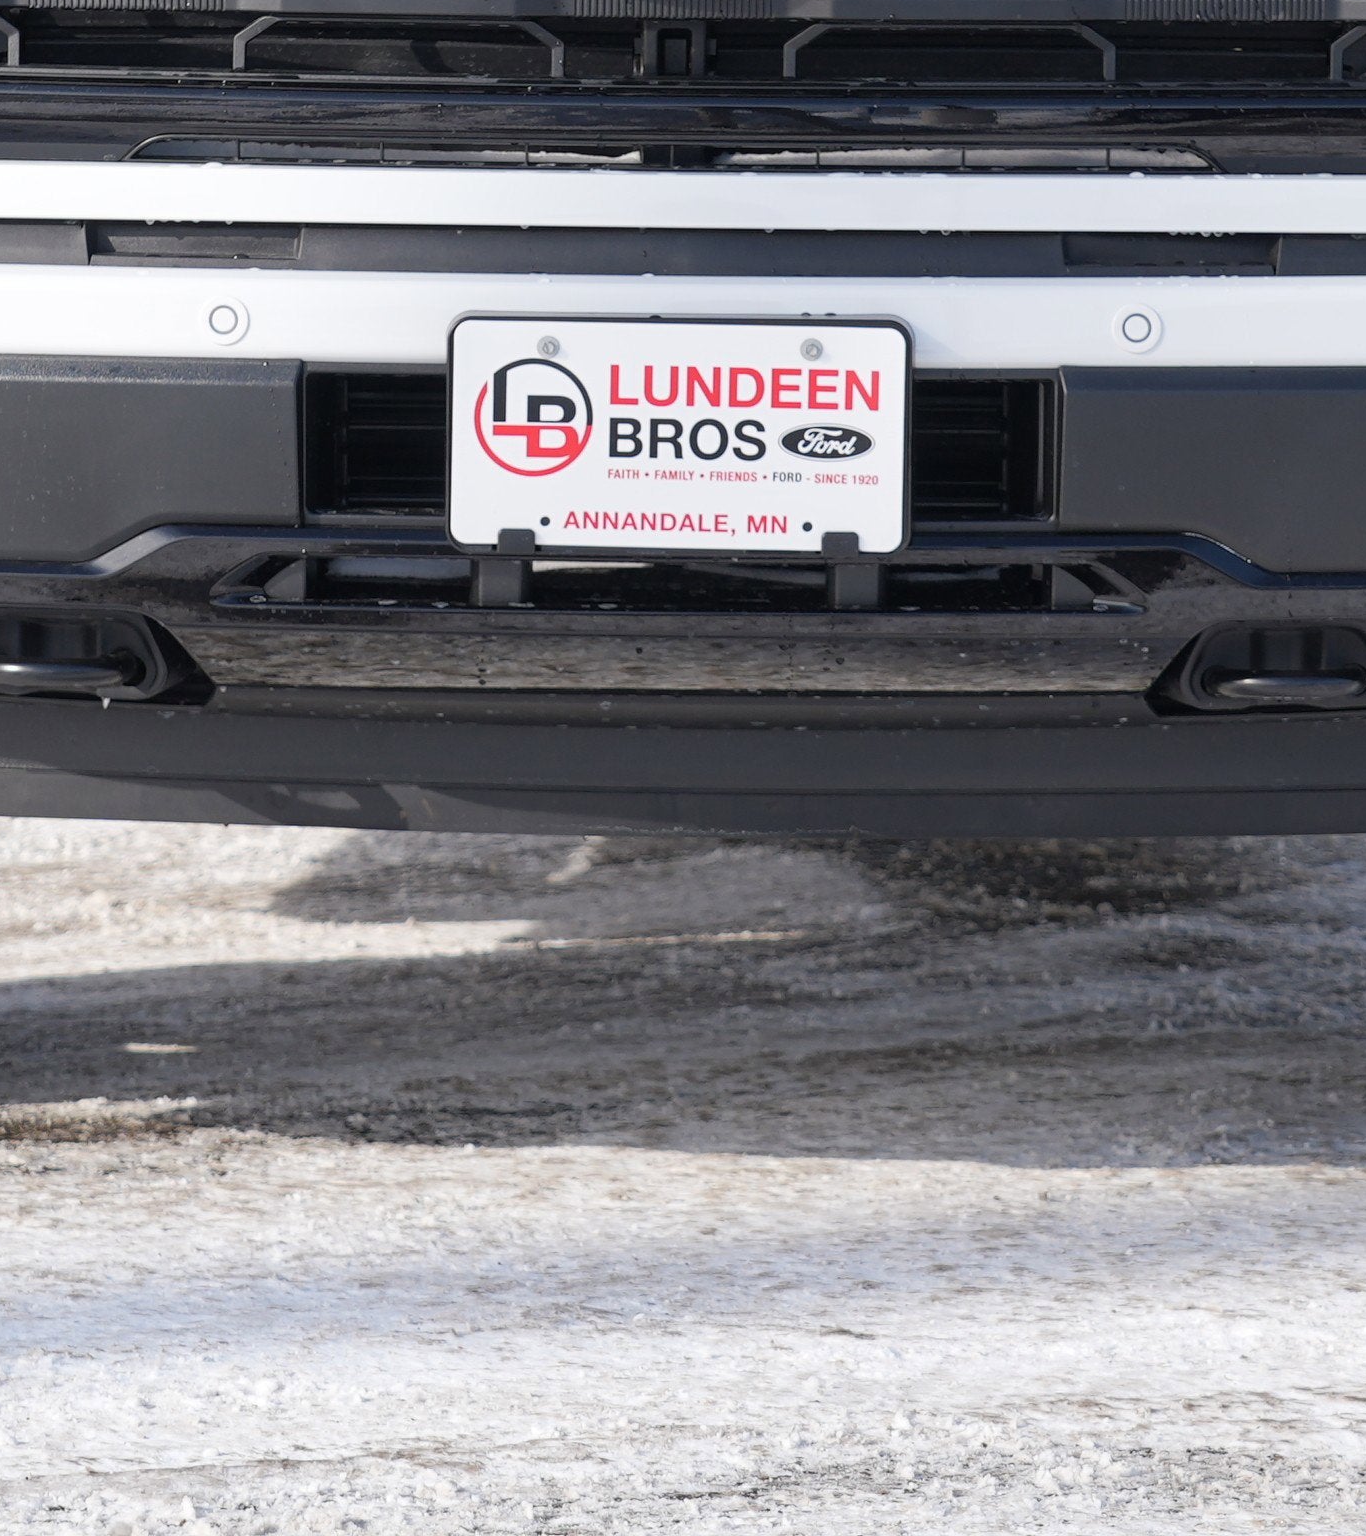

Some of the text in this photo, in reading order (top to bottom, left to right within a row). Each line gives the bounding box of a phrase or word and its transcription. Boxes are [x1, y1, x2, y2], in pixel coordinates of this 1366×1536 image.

[609, 364, 880, 411] LUNDEEN
[608, 417, 767, 461] BROS
[797, 427, 857, 455] Ford
[607, 468, 879, 486] FAITH FAMILY FRIENDS FORD SINCE 1920
[563, 510, 788, 536] ANNANDALE, MN
